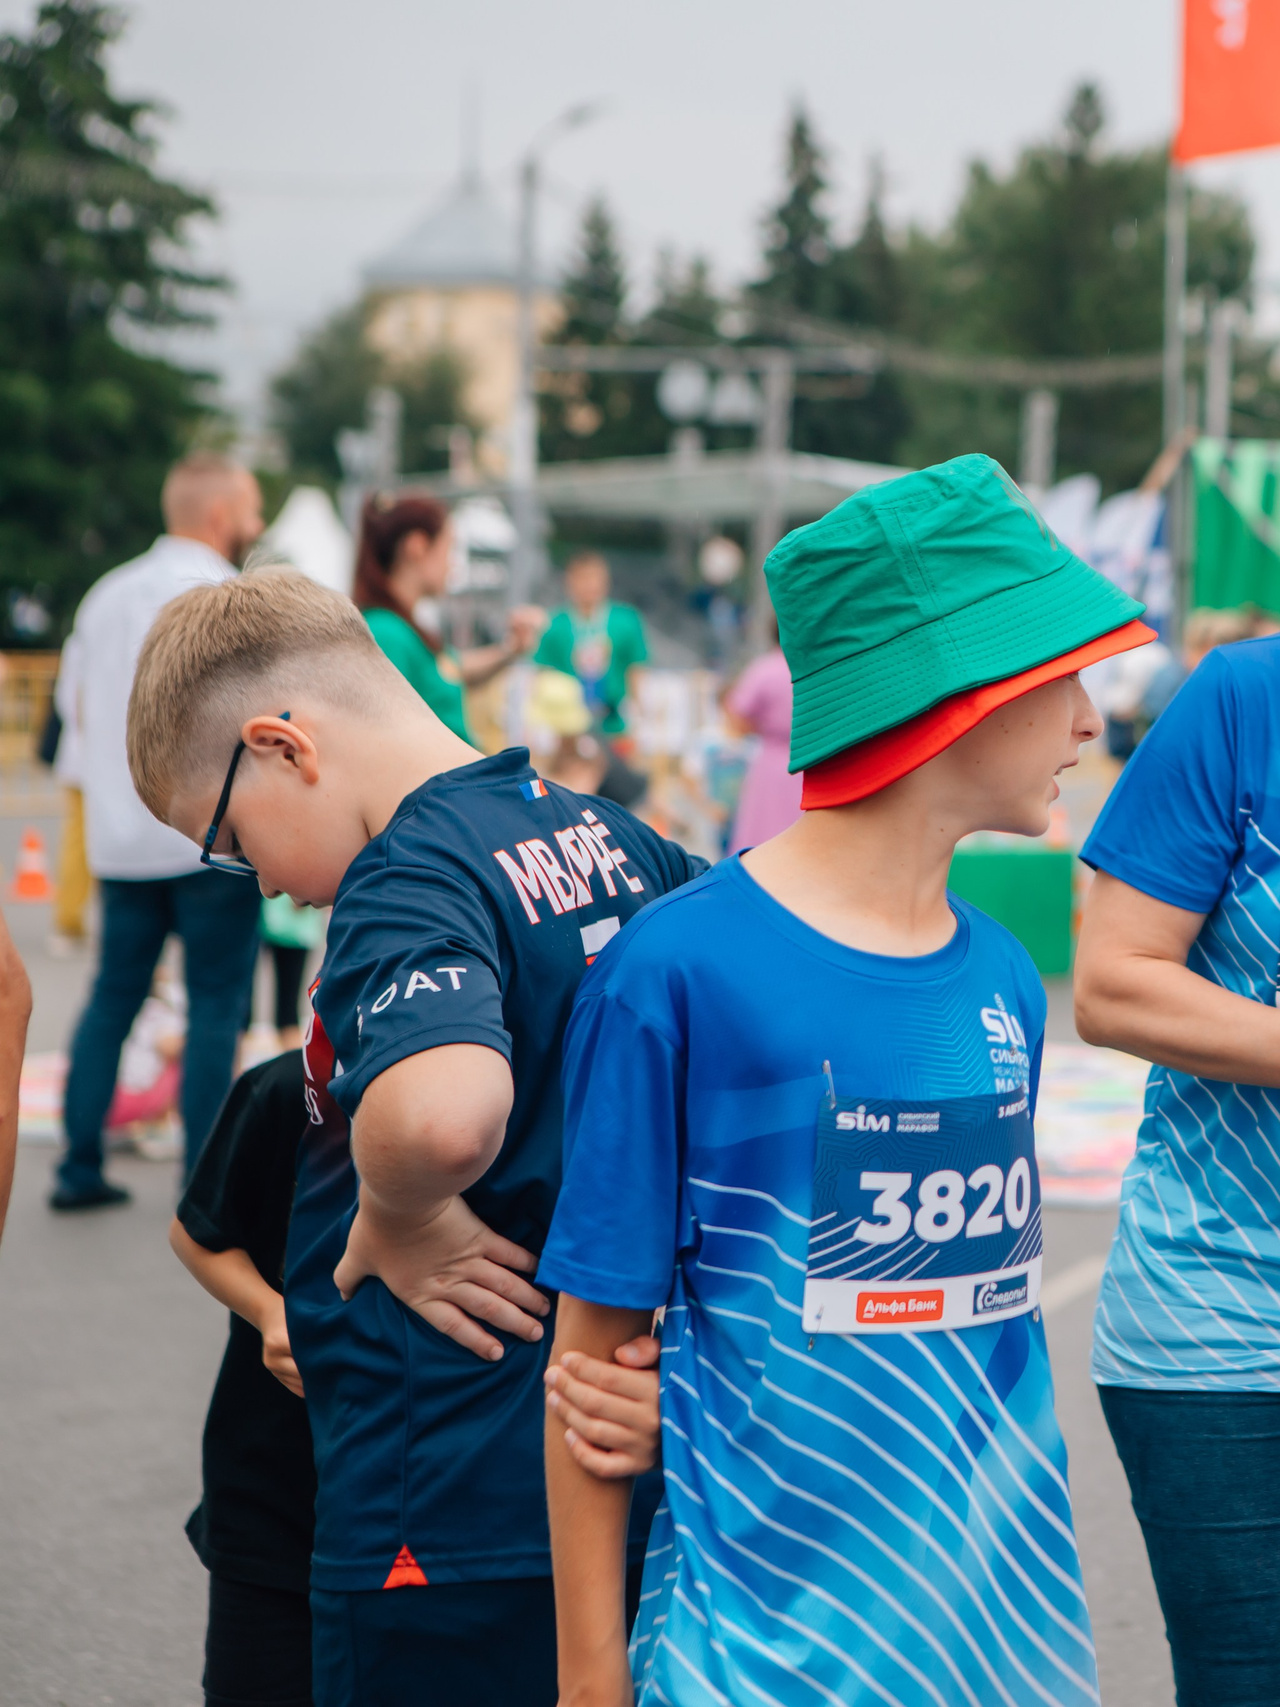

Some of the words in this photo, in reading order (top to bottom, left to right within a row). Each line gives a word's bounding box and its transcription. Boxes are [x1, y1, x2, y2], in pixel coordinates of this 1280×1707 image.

[357, 967, 467, 1037] OAT
[853, 1157, 1031, 1245] 3820
[863, 1299, 907, 1318] Альфа
[908, 1298, 938, 1314] Банк
